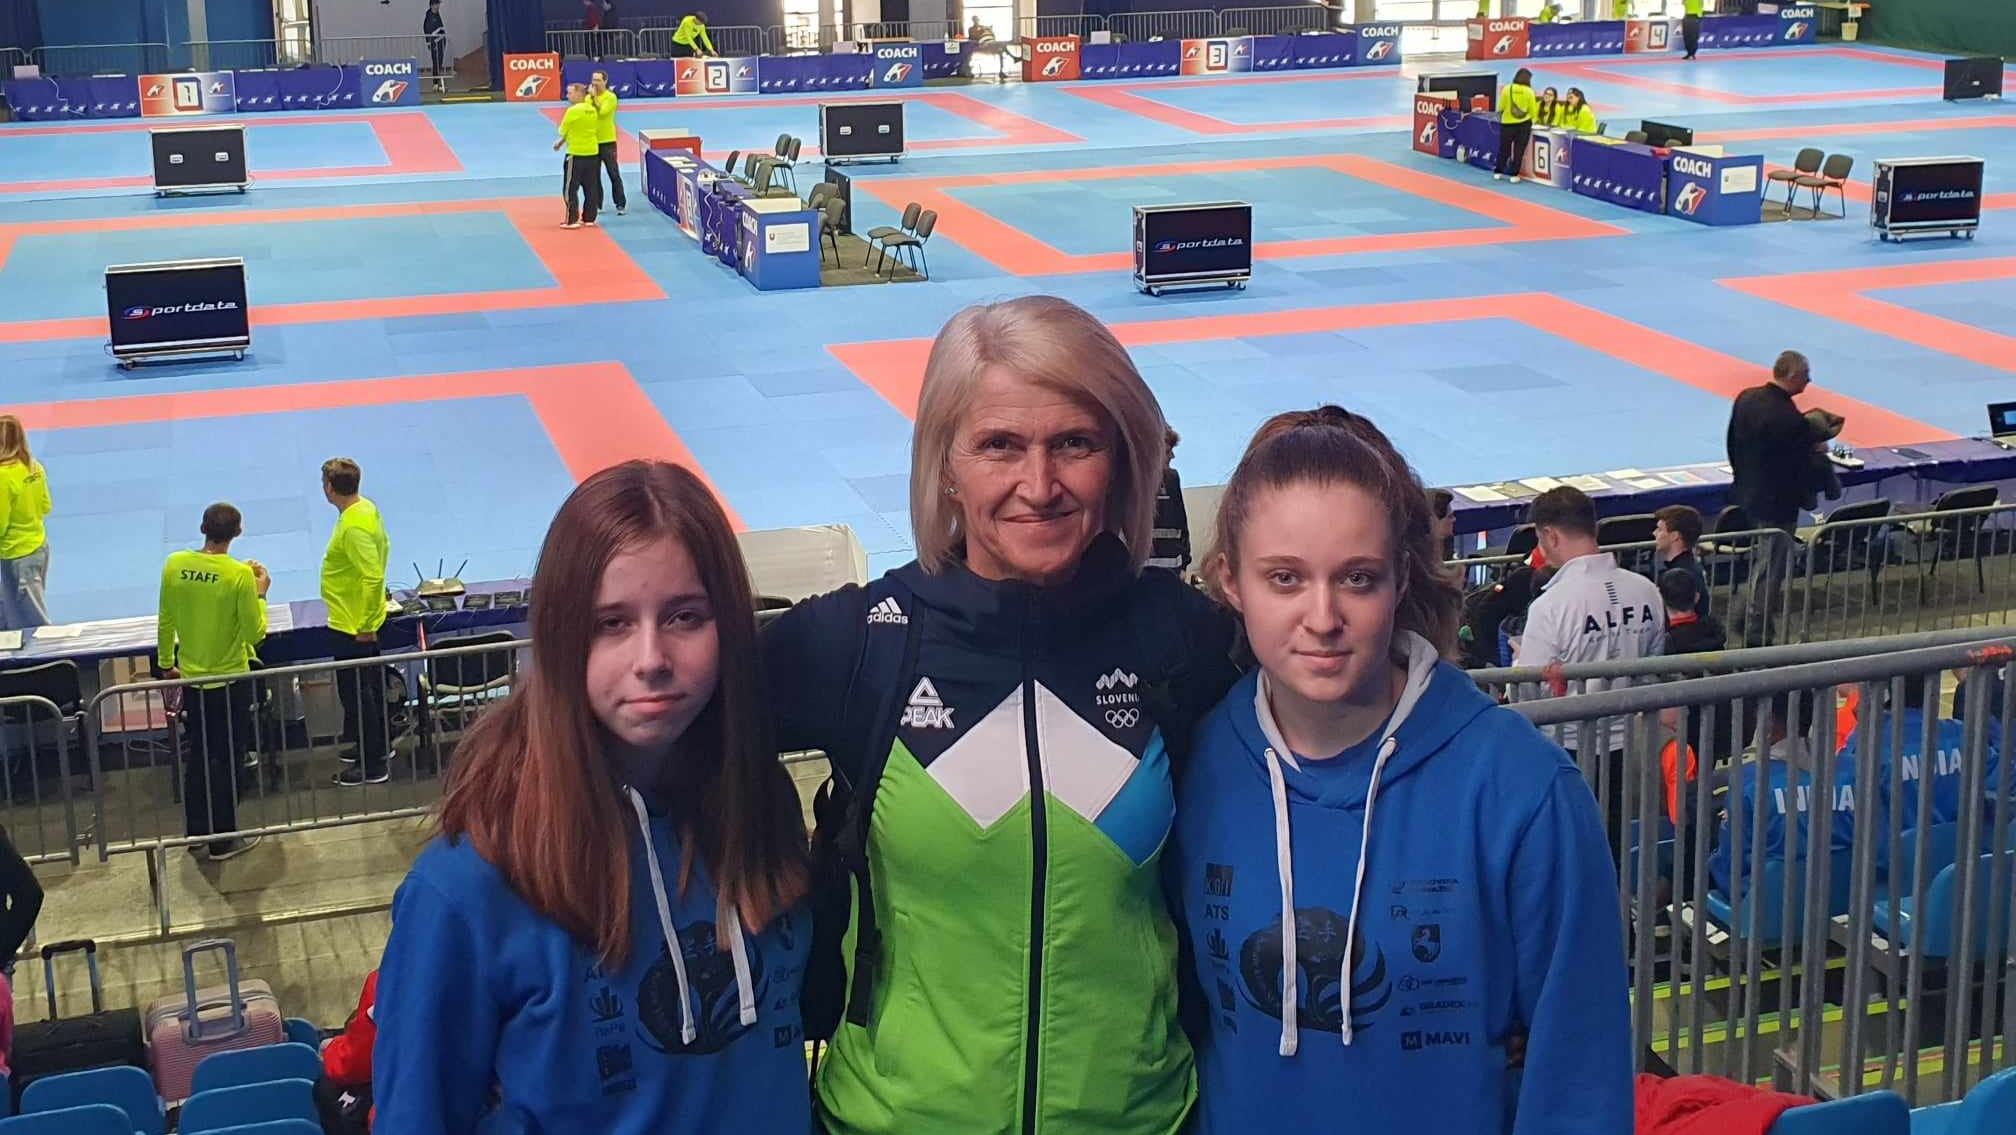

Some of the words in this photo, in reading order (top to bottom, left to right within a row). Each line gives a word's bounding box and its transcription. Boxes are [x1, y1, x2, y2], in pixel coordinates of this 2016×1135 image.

[1781, 8, 1815, 19] COACH
[1362, 26, 1399, 38] COACH
[1489, 21, 1525, 32] COACH
[1654, 28, 1663, 42] 4
[877, 47, 918, 60] COACH
[1036, 41, 1075, 53] COACH
[1212, 47, 1222, 64] 3
[365, 63, 412, 76] COACH
[510, 58, 554, 71] COACH
[712, 69, 723, 86] 2
[184, 85, 192, 104] 1
[1417, 101, 1445, 116] COAC
[1537, 146, 1546, 170] 6
[1673, 156, 1712, 178] COACH
[180, 569, 219, 584] STAFF
[867, 611, 909, 625] adidas
[1583, 604, 1654, 635] ALFA
[900, 705, 955, 729] PEAK
[1204, 903, 1230, 921] ATS
[1425, 1031, 1470, 1046] MAVI
